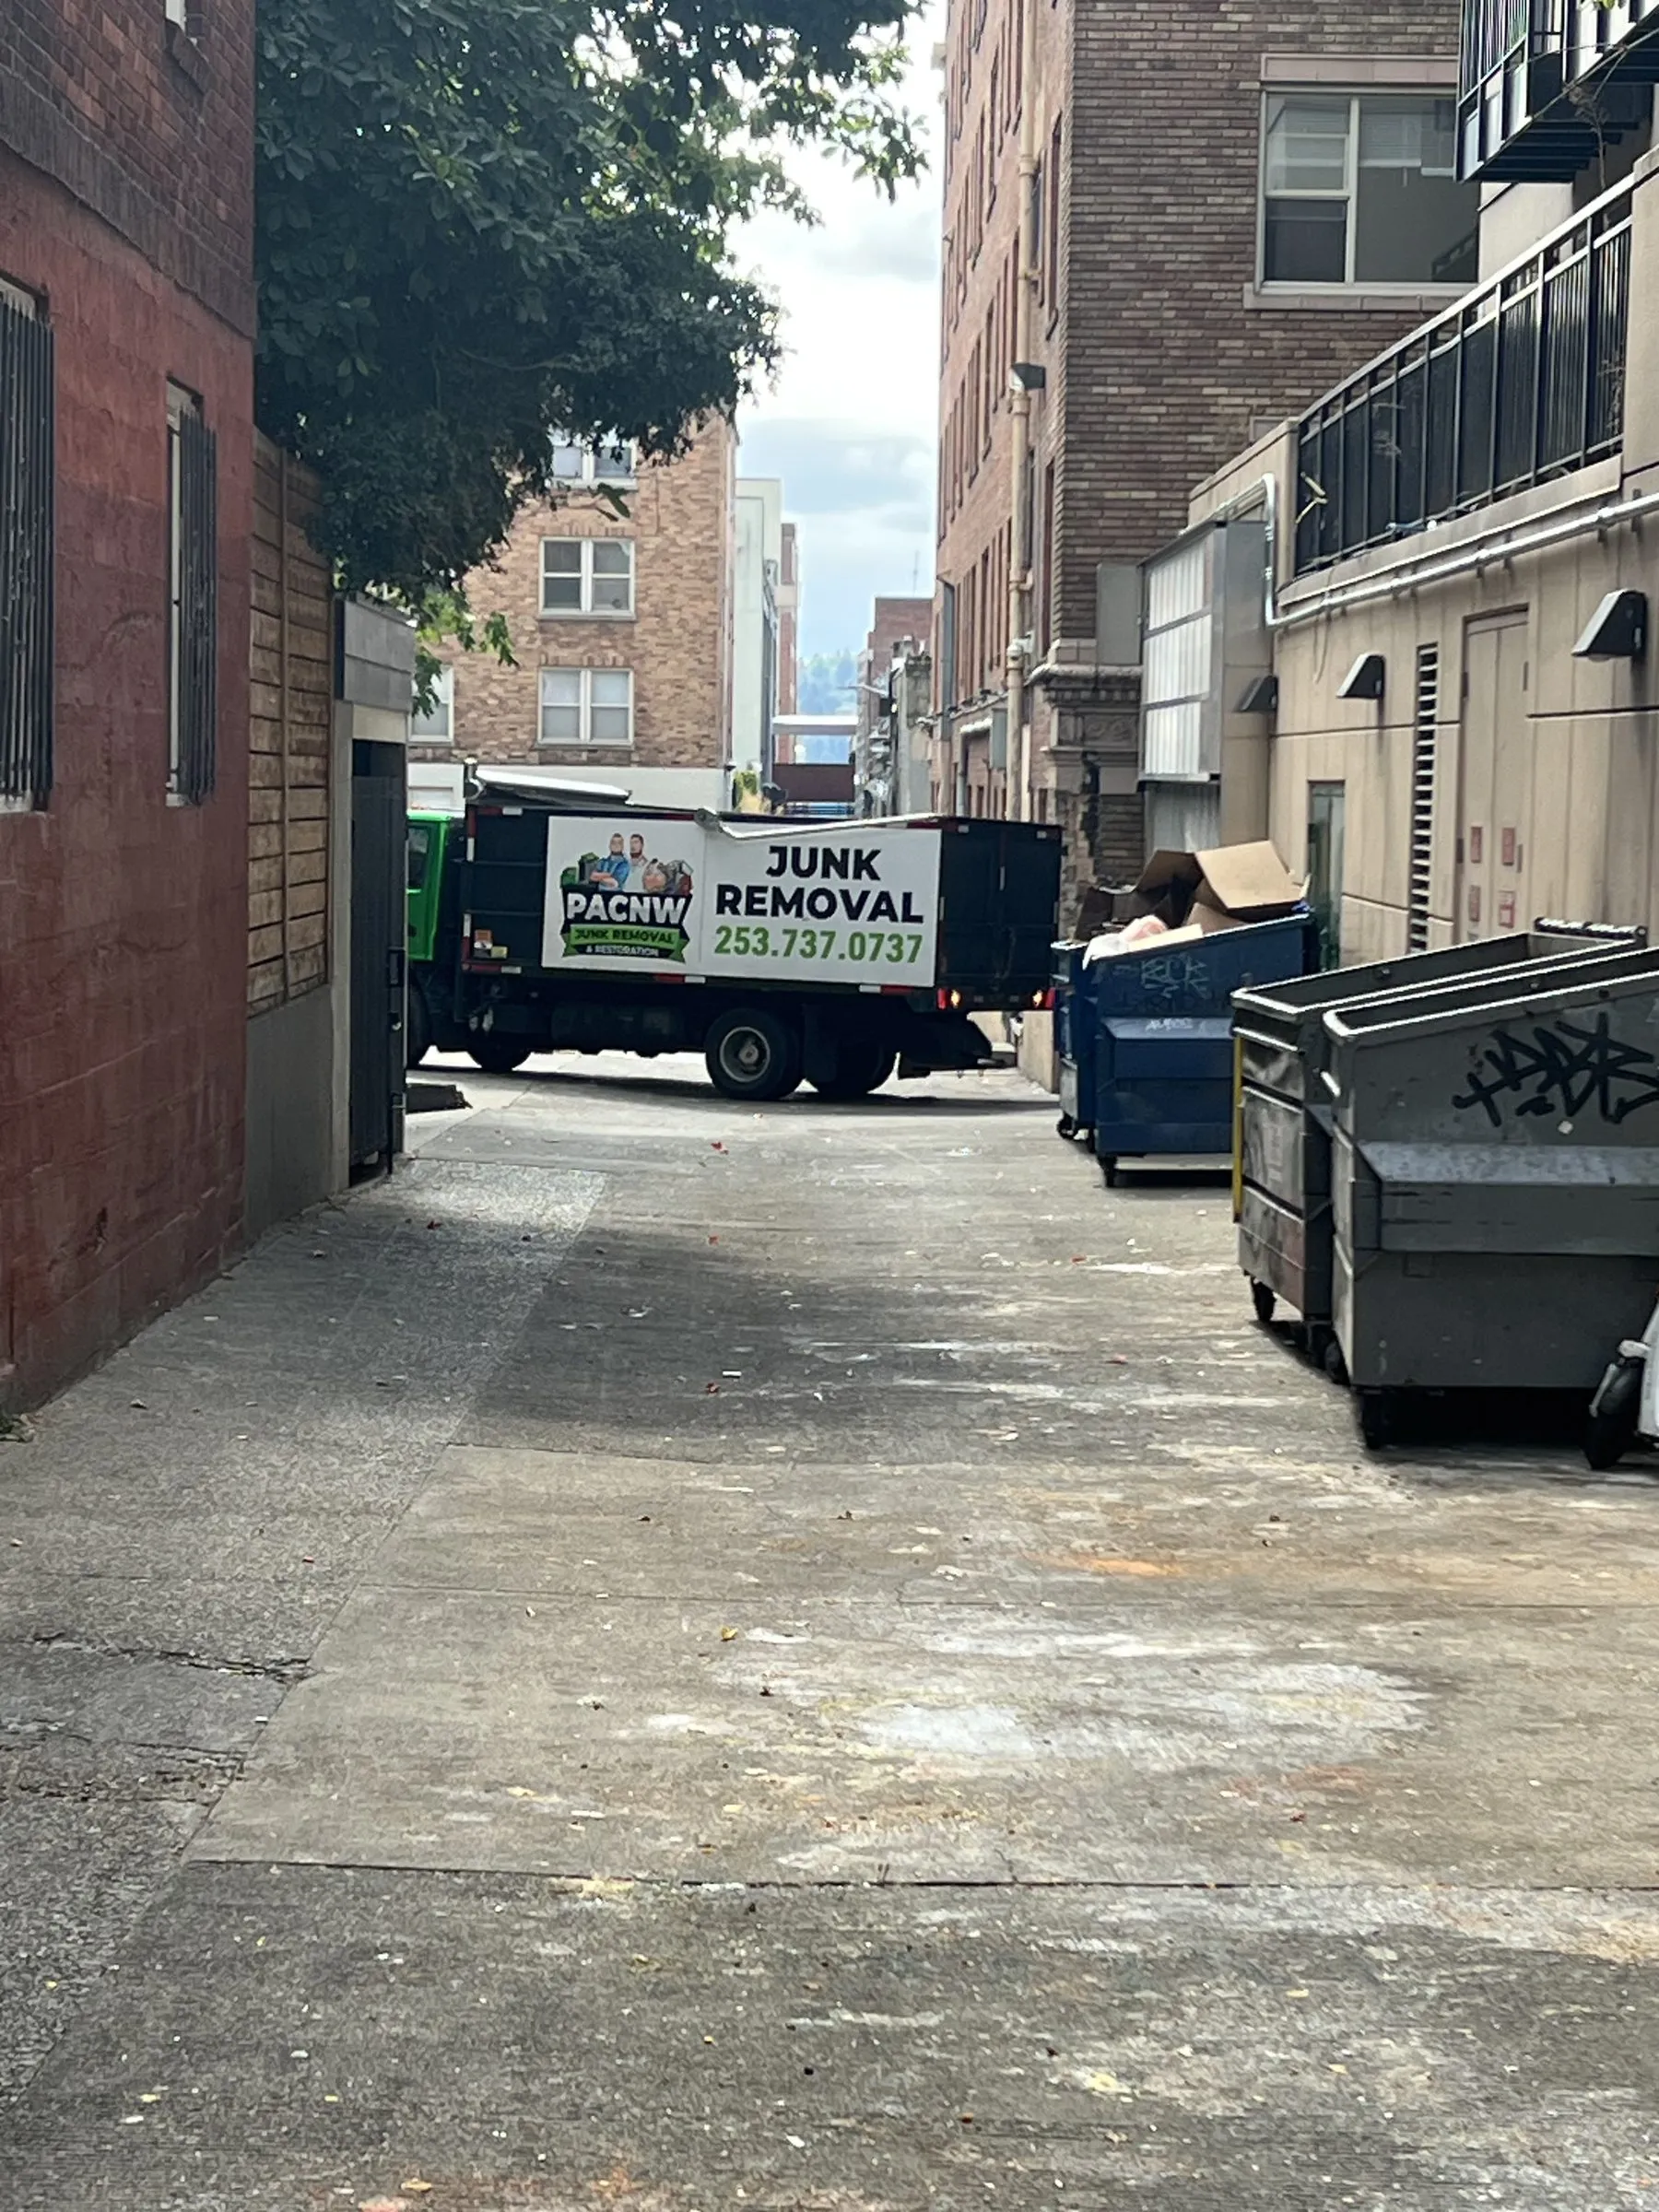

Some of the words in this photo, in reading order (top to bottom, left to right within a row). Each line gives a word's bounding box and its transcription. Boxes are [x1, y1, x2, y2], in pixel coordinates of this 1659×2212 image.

[766, 845, 881, 881] JUNK
[567, 892, 686, 924] PACNW
[715, 883, 924, 924] REMOVAL
[575, 929, 609, 940] JUNK
[612, 929, 675, 944] REMOVAL
[714, 925, 923, 963] 253.737.0737
